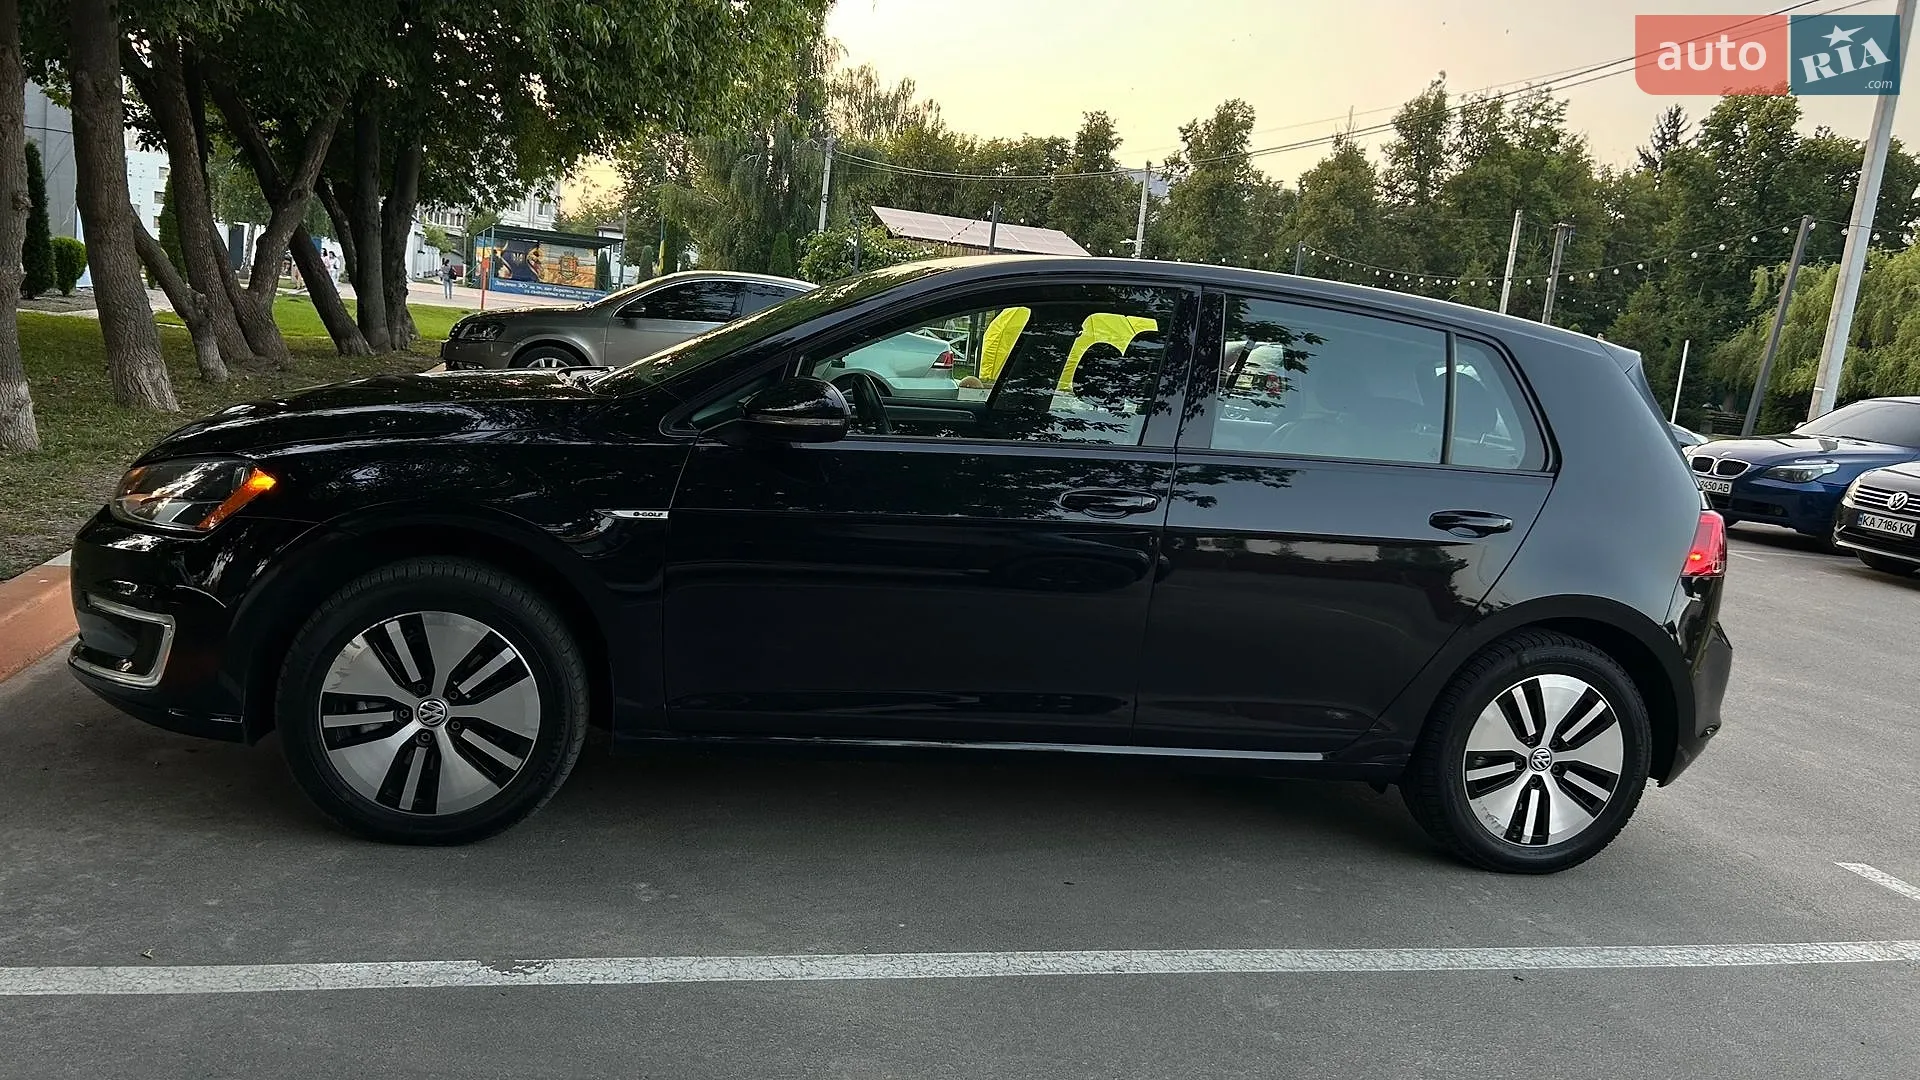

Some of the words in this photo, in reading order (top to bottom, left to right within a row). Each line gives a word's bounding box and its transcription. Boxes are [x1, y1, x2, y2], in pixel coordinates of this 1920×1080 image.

[1717, 483, 1729, 493] AB
[1862, 516, 1875, 528] KA
[1877, 518, 1898, 532] 7186
[1899, 522, 1915, 536] KK
